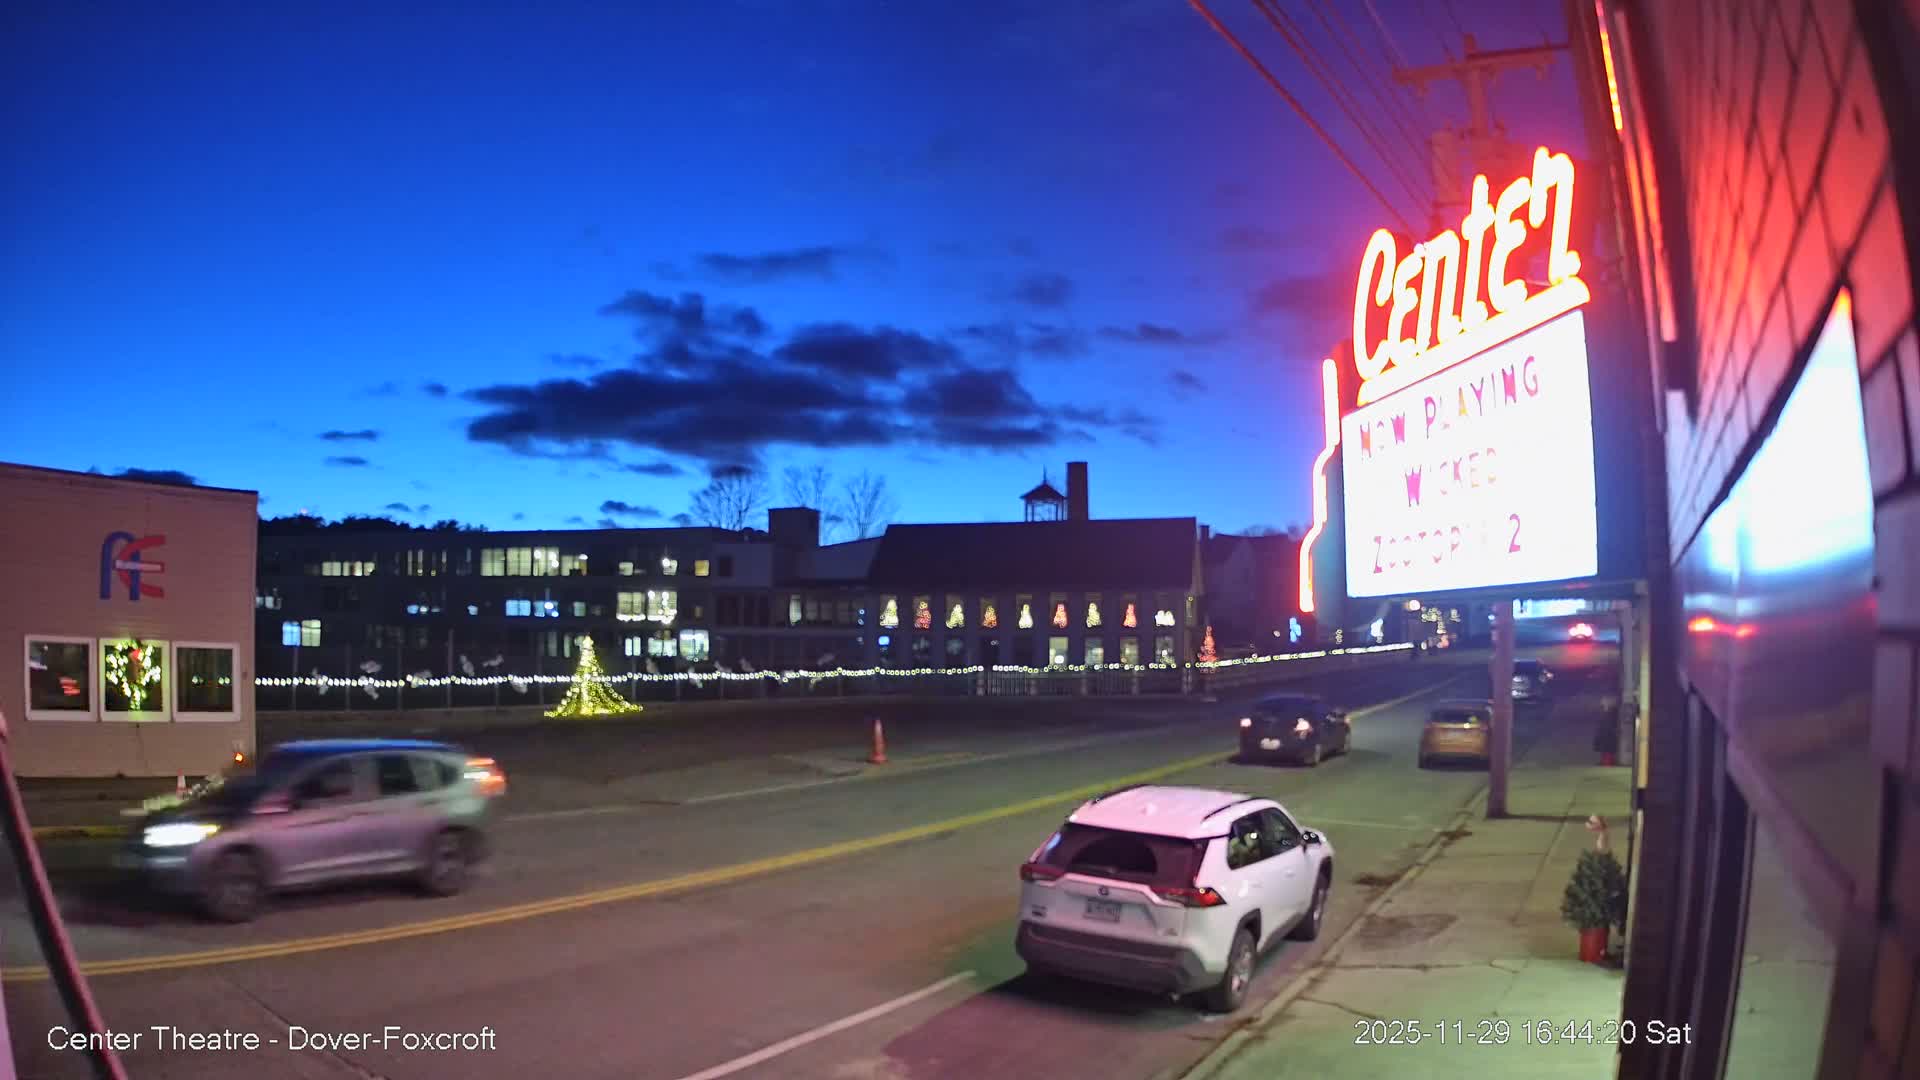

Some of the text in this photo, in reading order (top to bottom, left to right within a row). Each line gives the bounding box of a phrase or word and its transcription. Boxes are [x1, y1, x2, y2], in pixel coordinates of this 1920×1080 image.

[1354, 147, 1581, 382] Center
[1359, 355, 1539, 459] NOW PLAYING
[1404, 446, 1498, 508] WCKED
[1372, 513, 1522, 575] ZOOTOP 2
